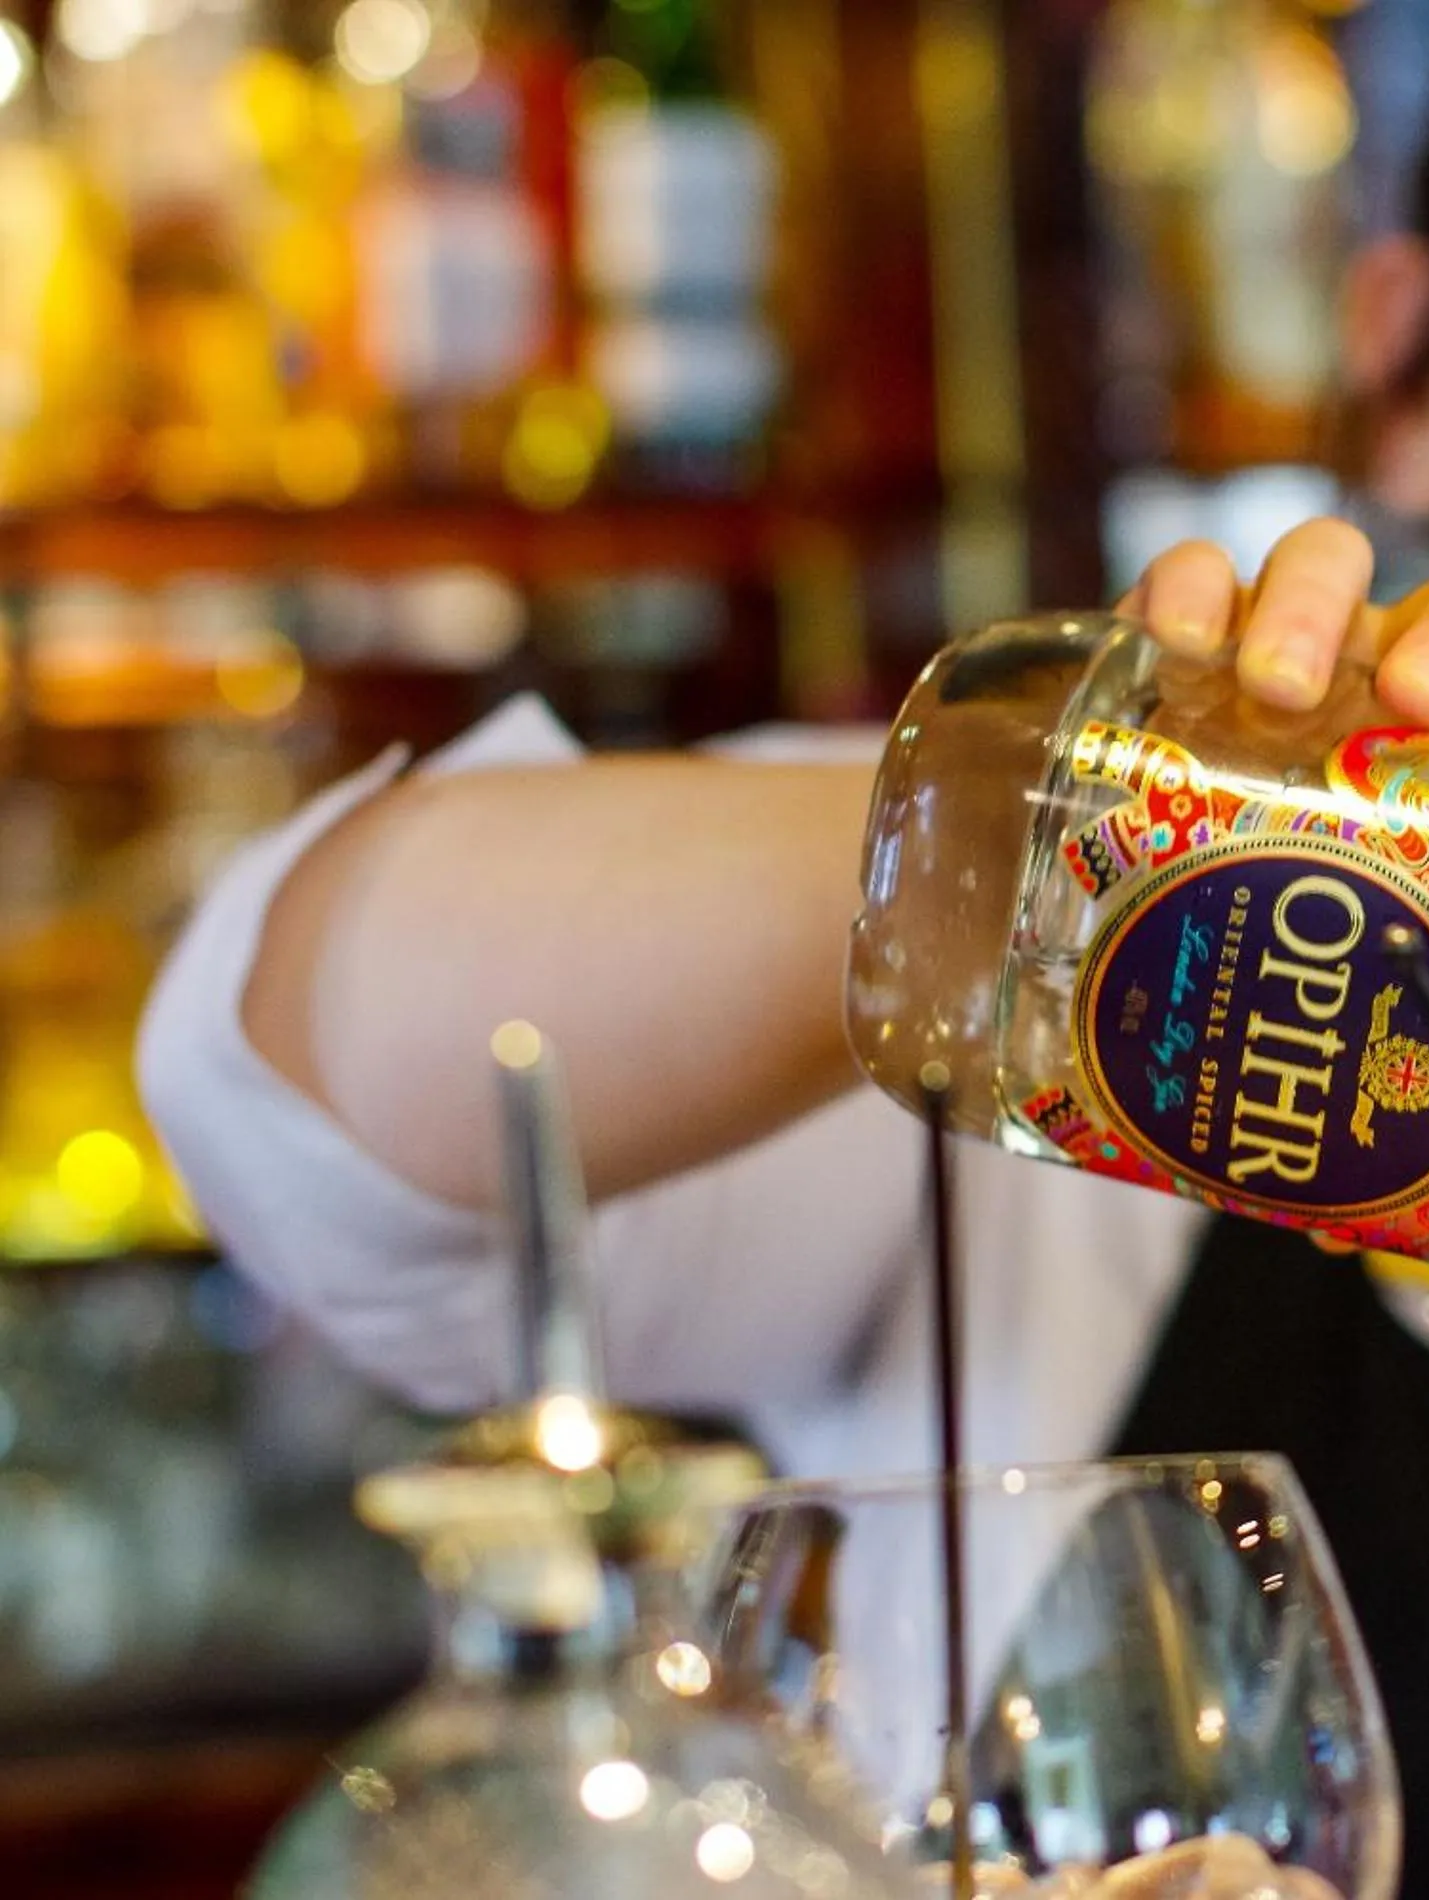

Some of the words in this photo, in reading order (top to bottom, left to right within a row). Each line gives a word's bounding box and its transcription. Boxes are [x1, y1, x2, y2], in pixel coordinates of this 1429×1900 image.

[1205, 885, 1251, 1041] ORIENTAL
[1226, 875, 1366, 1185] OPIHR
[1190, 1058, 1220, 1155] SPICED
